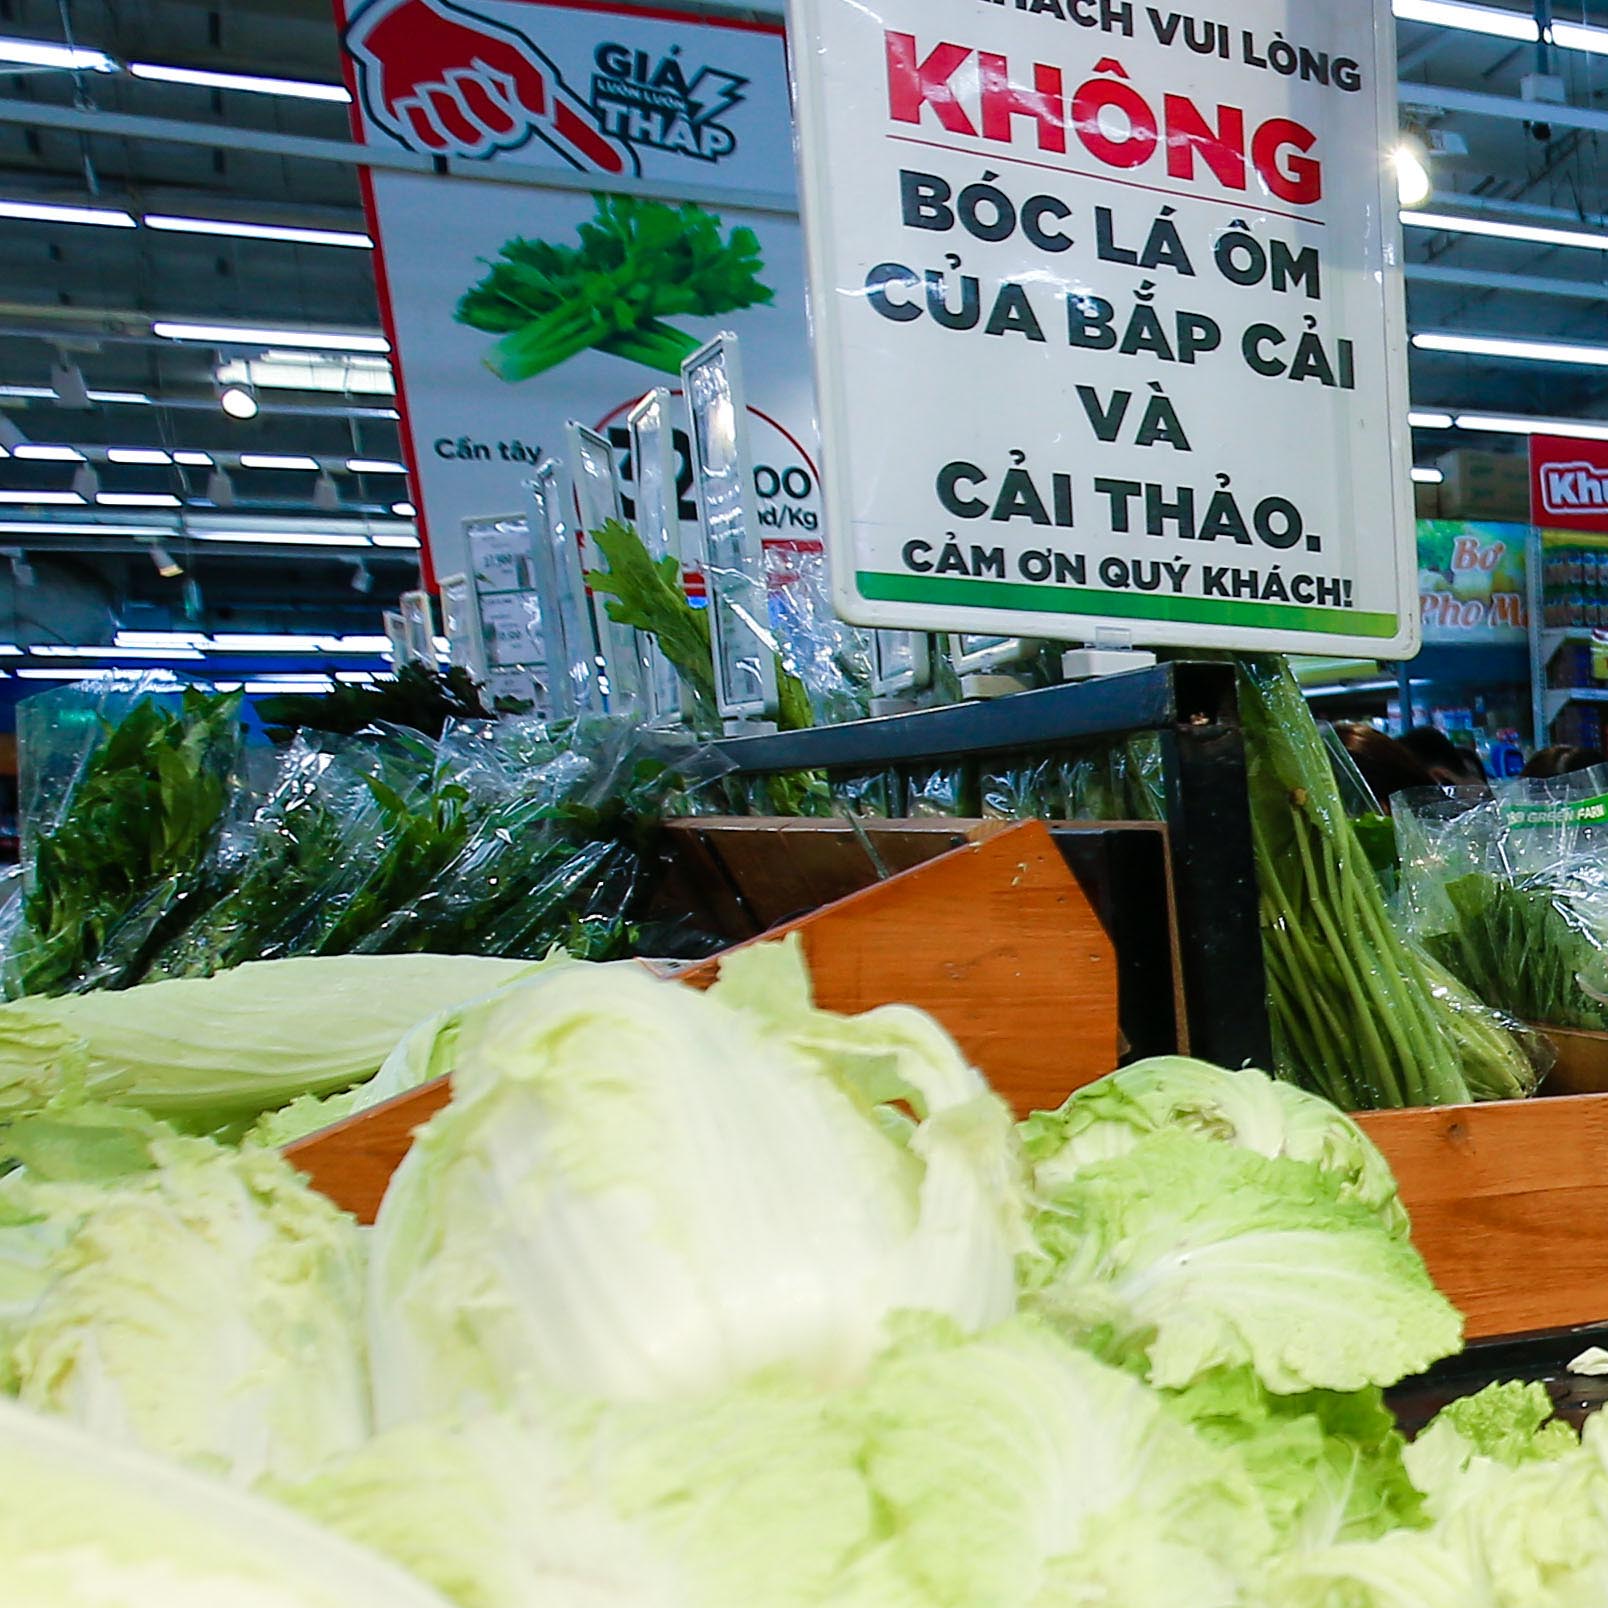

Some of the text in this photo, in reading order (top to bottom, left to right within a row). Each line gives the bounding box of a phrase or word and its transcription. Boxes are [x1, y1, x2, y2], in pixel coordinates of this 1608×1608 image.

[1146, 11, 1228, 59] VUI
[1243, 30, 1361, 91] LÒNG
[884, 30, 1321, 204] KHÔNG
[899, 168, 1320, 299] BÓC LÁ ÔM
[865, 253, 1355, 389] CỦA BẮP CẢI
[498, 439, 543, 467] tây
[1075, 381, 1191, 451] VÀ
[936, 450, 1321, 551] CẢI THẢO.
[902, 533, 1352, 608] CẢM ƠN QUÝ KHÁCH!
[1452, 536, 1505, 572] Bơ
